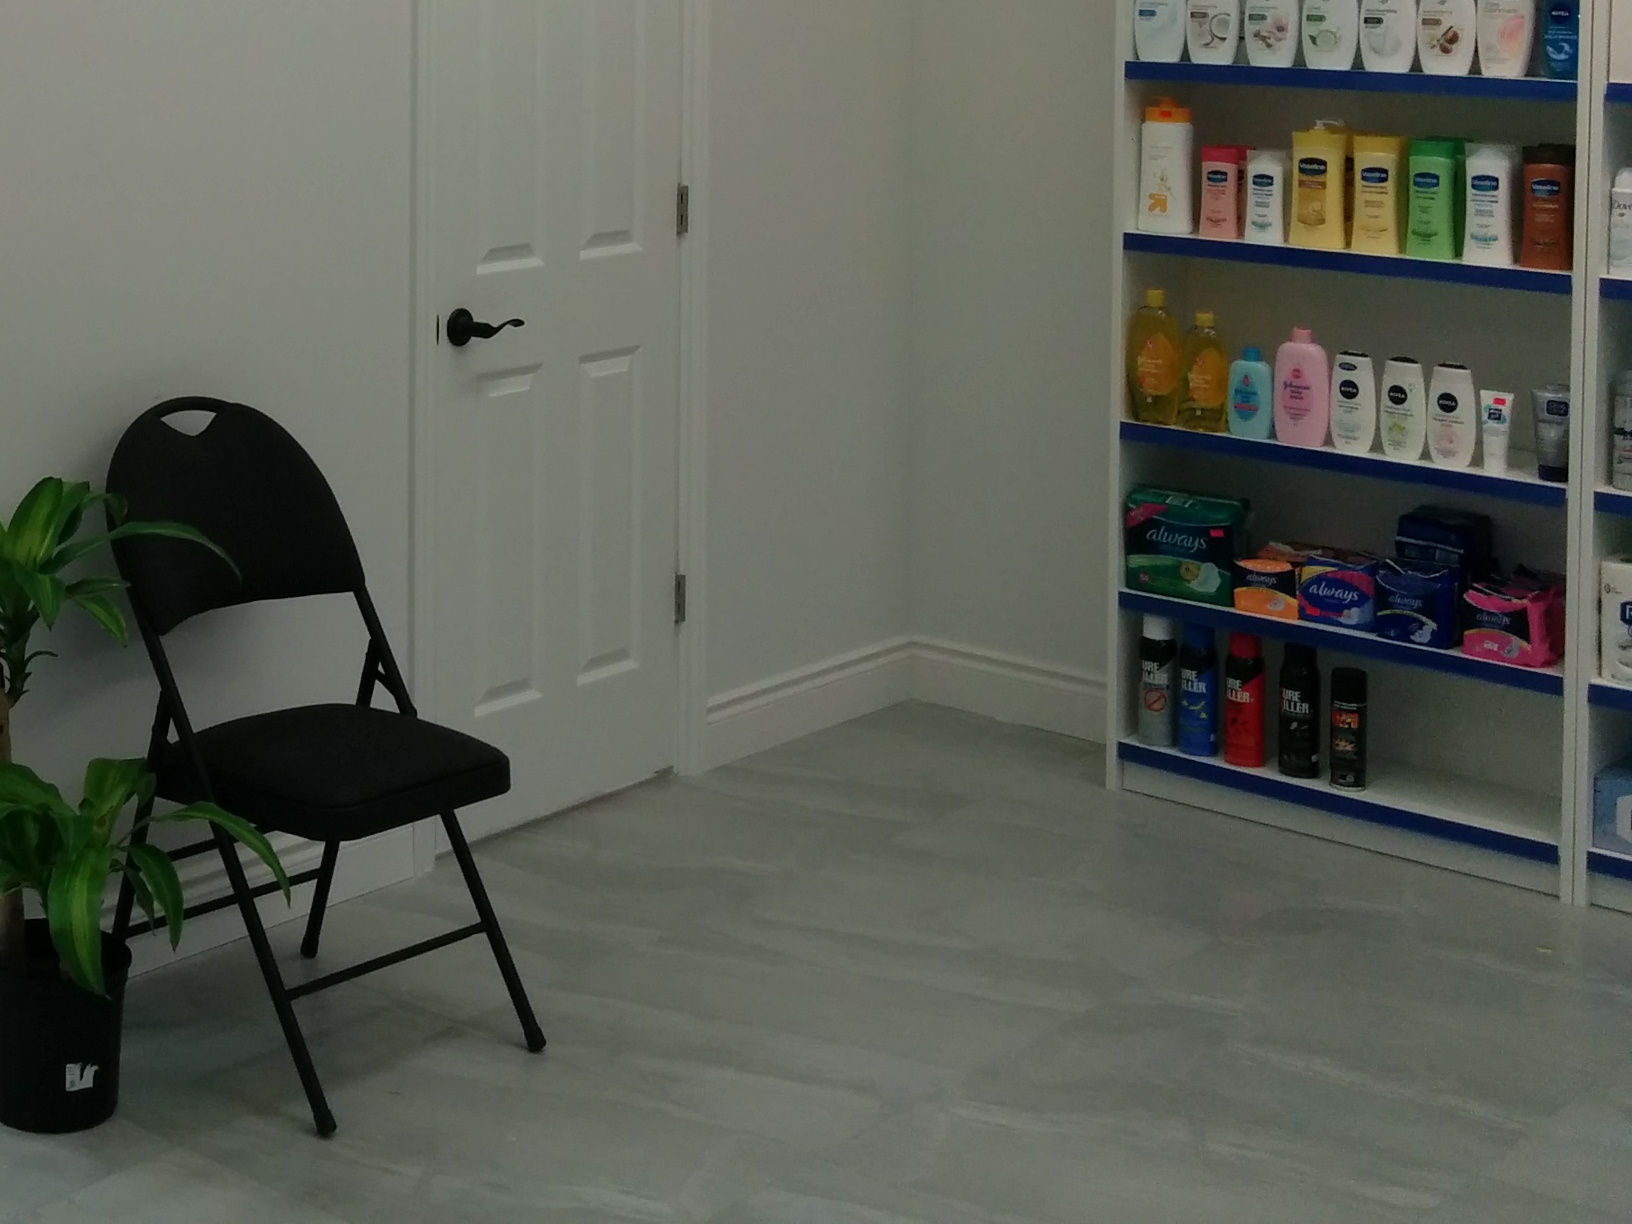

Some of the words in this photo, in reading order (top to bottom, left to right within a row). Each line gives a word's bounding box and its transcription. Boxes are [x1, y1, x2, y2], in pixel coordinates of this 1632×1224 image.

[1146, 525, 1208, 553] always
[1246, 573, 1278, 586] always
[1308, 580, 1360, 605] always
[1388, 592, 1424, 608] always
[1476, 610, 1512, 626] always
